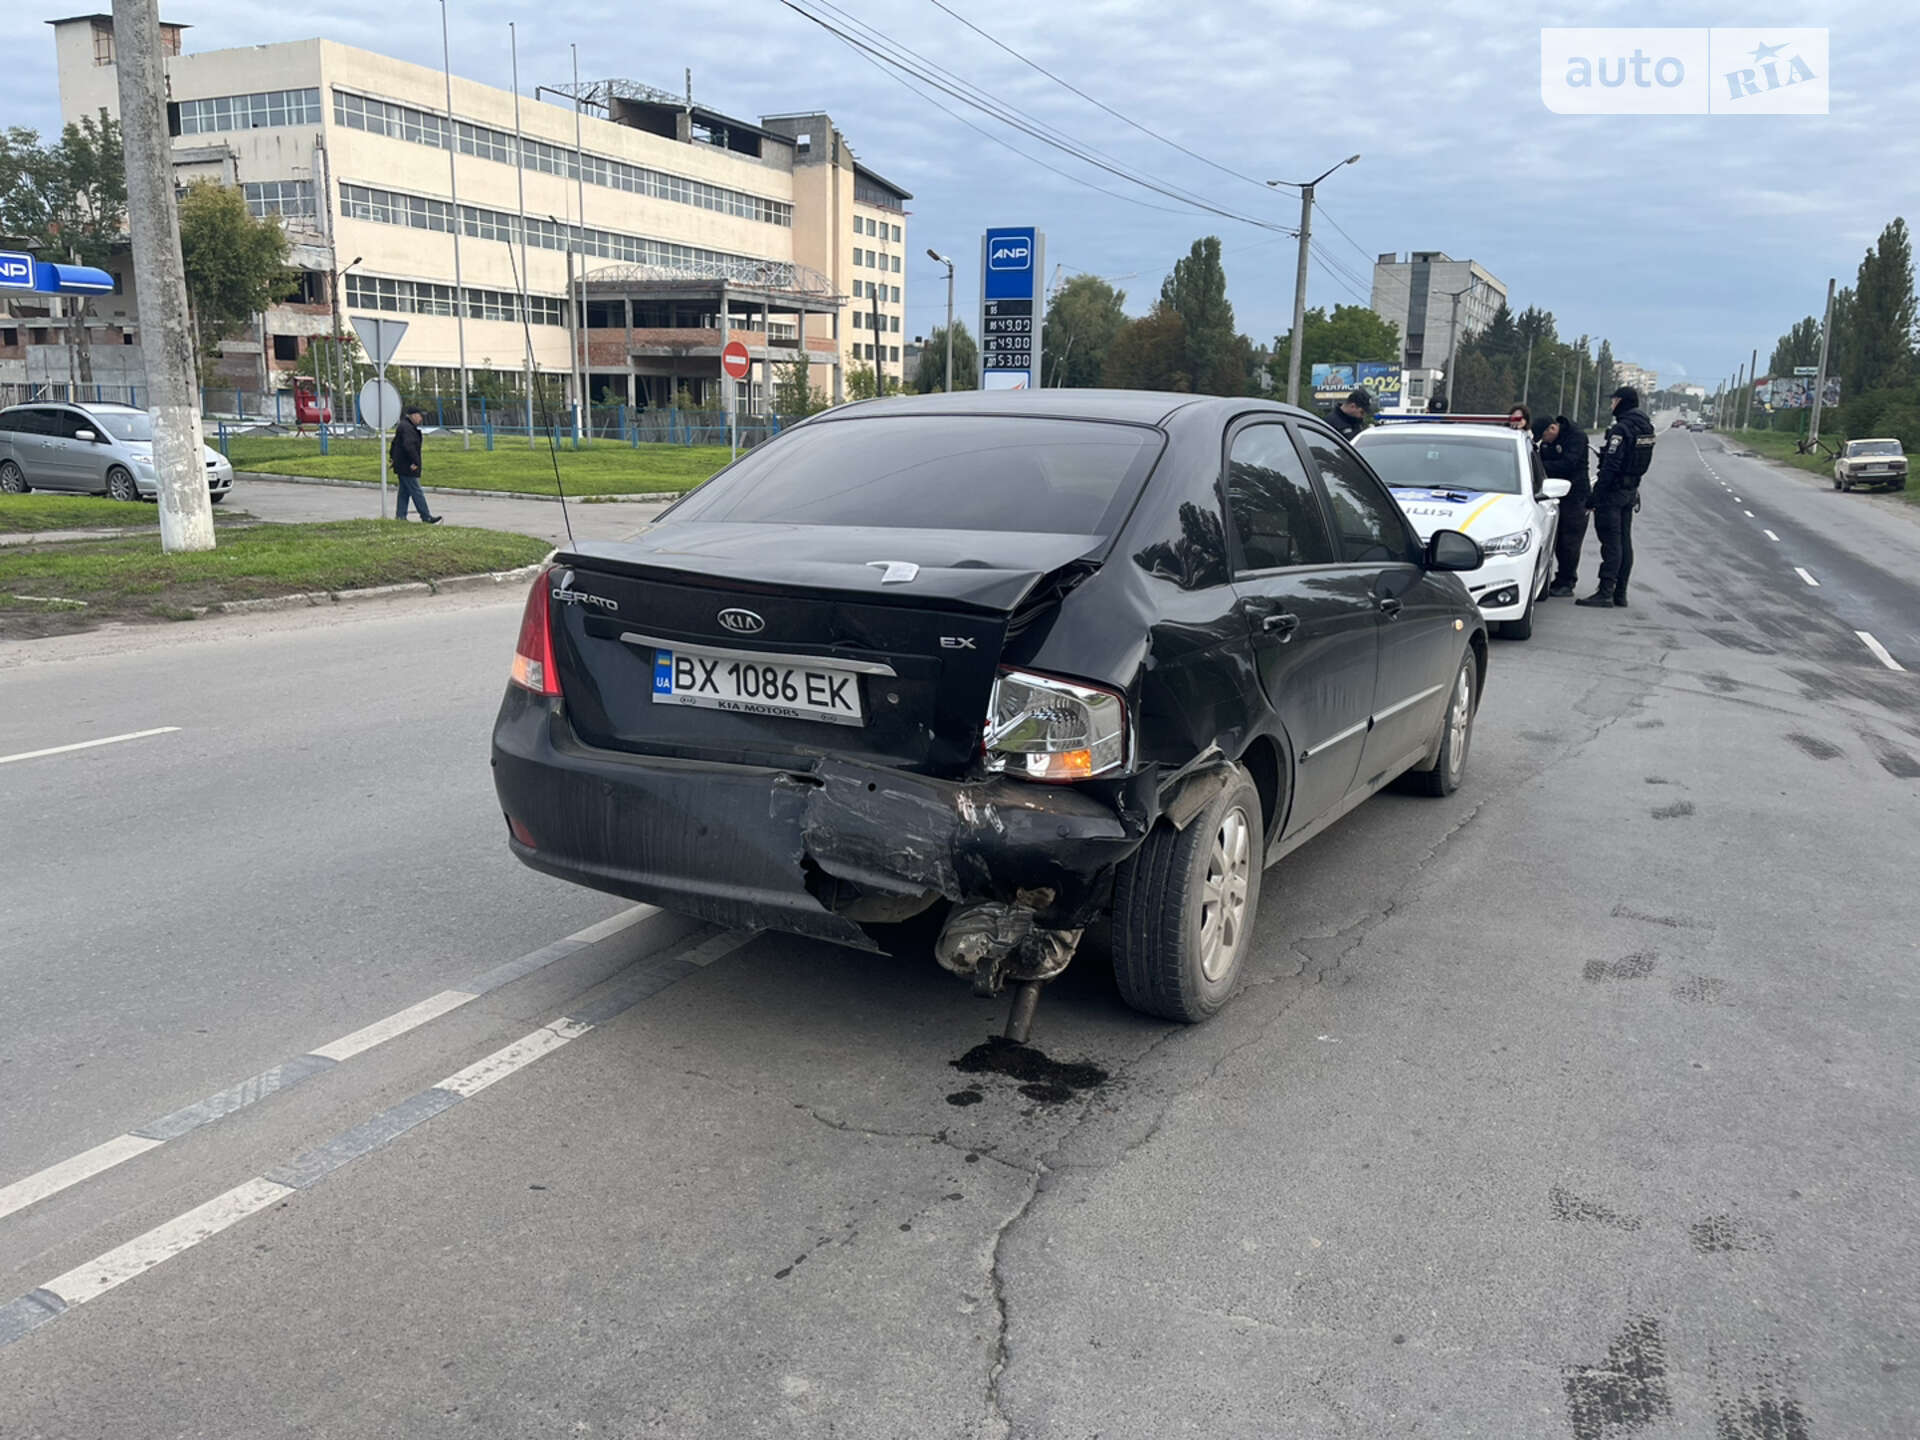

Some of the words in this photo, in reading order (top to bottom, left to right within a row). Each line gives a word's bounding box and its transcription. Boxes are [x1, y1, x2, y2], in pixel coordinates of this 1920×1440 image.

[992, 247, 1029, 259] ANP
[0, 262, 27, 277] NP
[998, 337, 1030, 349] 49.00
[998, 354, 1030, 367] 53.00
[552, 588, 619, 611] CERATO
[723, 613, 756, 629] KIA
[940, 636, 977, 649] EX
[656, 676, 671, 689] UA
[674, 657, 720, 694] BX
[727, 662, 800, 702] 1086
[805, 671, 853, 710] EK
[717, 700, 740, 711] KIA
[743, 703, 800, 717] MOTORS
